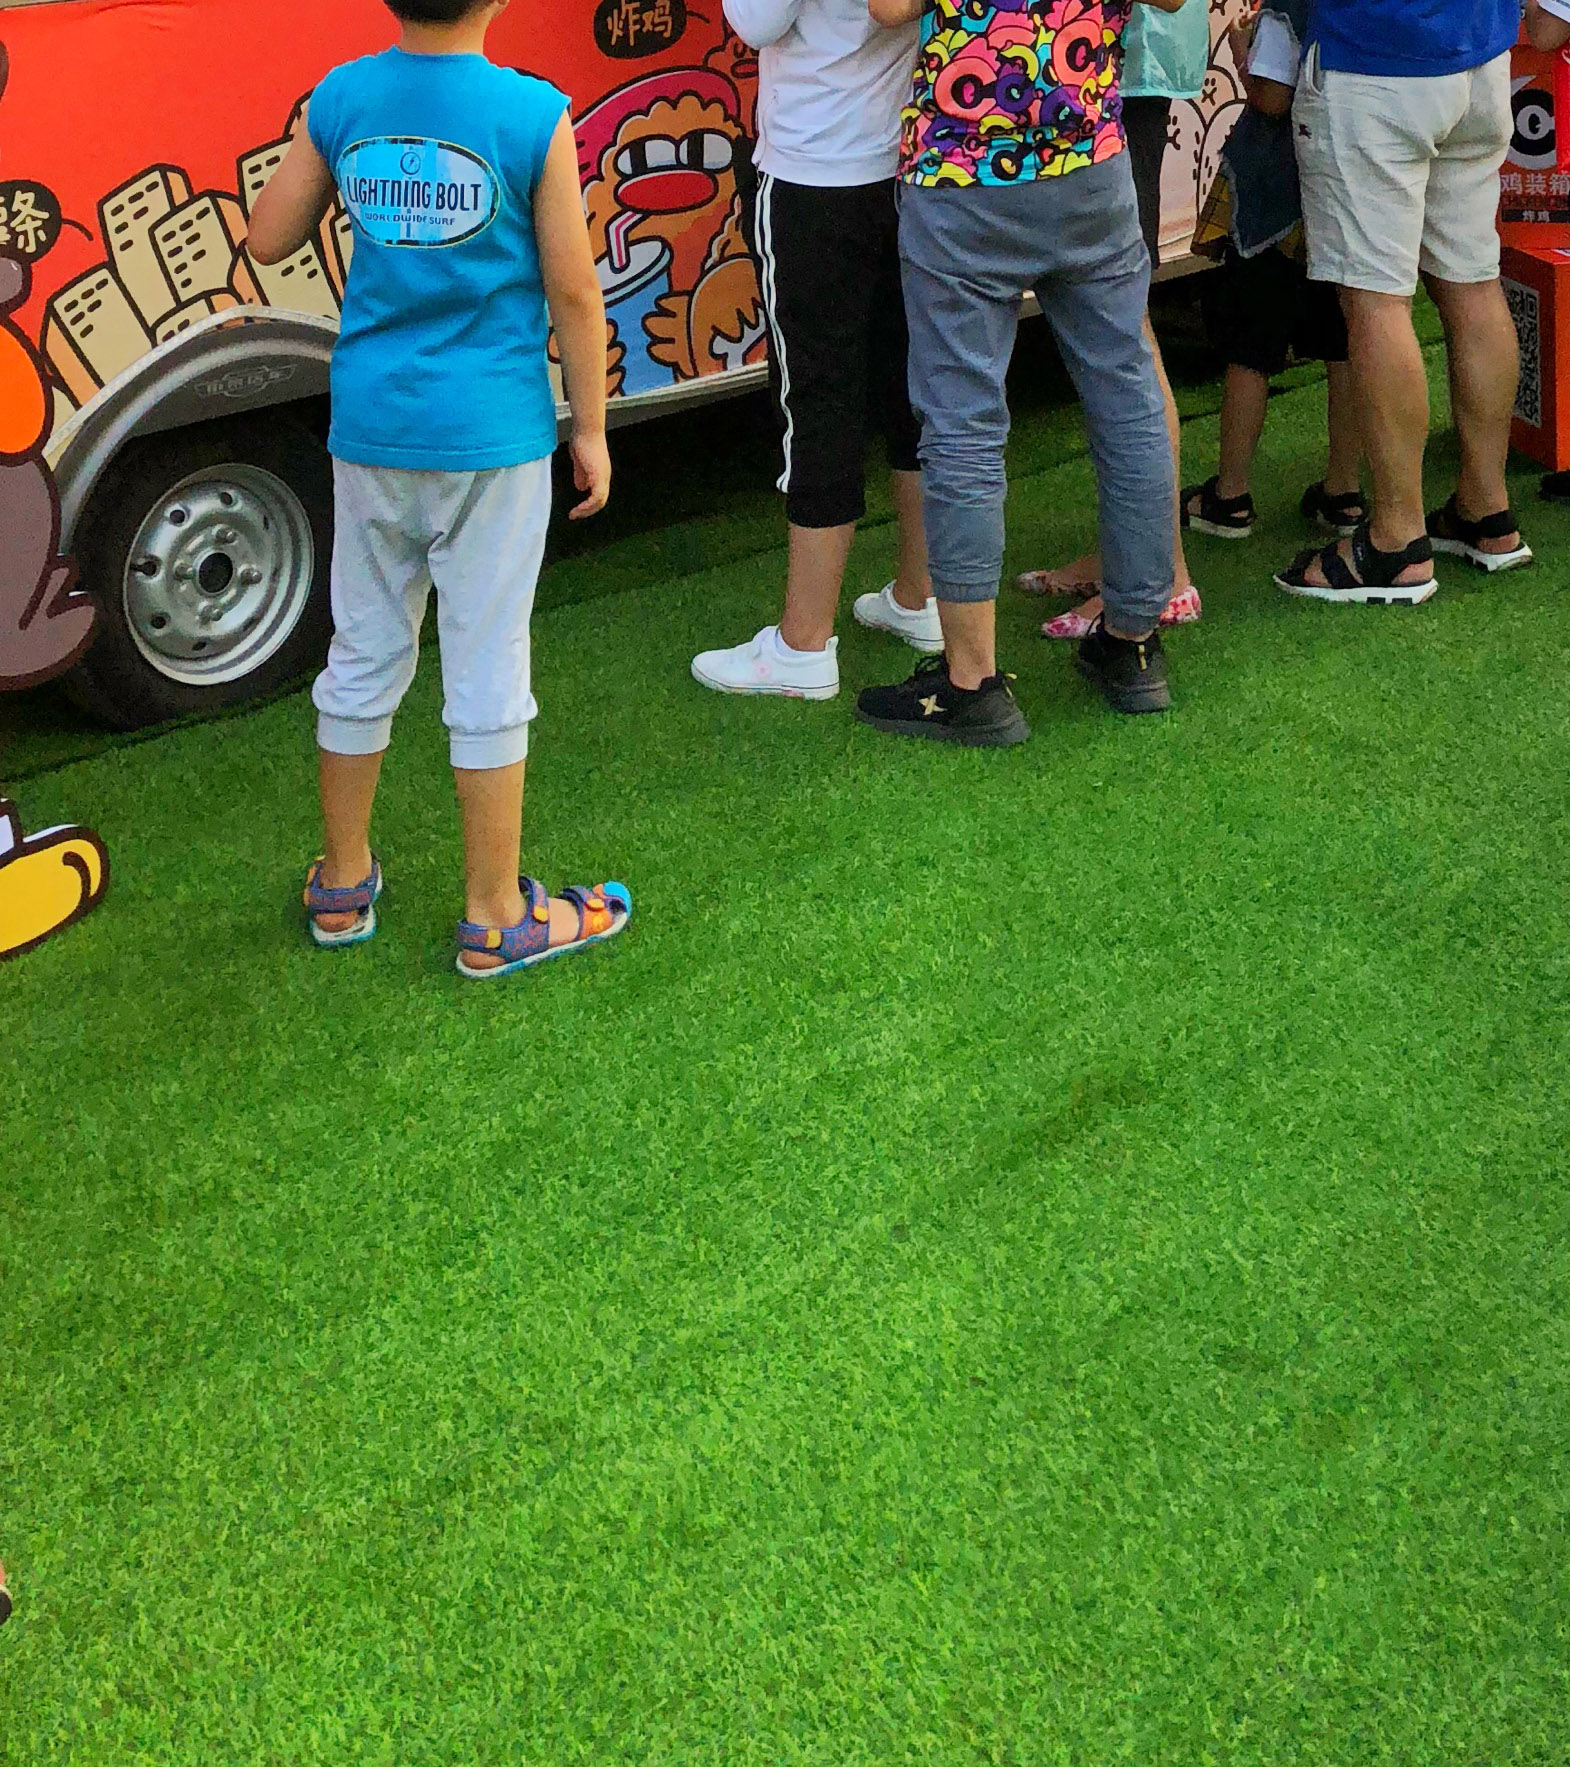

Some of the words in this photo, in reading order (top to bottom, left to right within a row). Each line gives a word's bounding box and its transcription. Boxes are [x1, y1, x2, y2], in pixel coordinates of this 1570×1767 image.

[346, 175, 431, 209] LIGHTNING
[435, 182, 482, 211] BOLT
[429, 216, 456, 226] SURF
